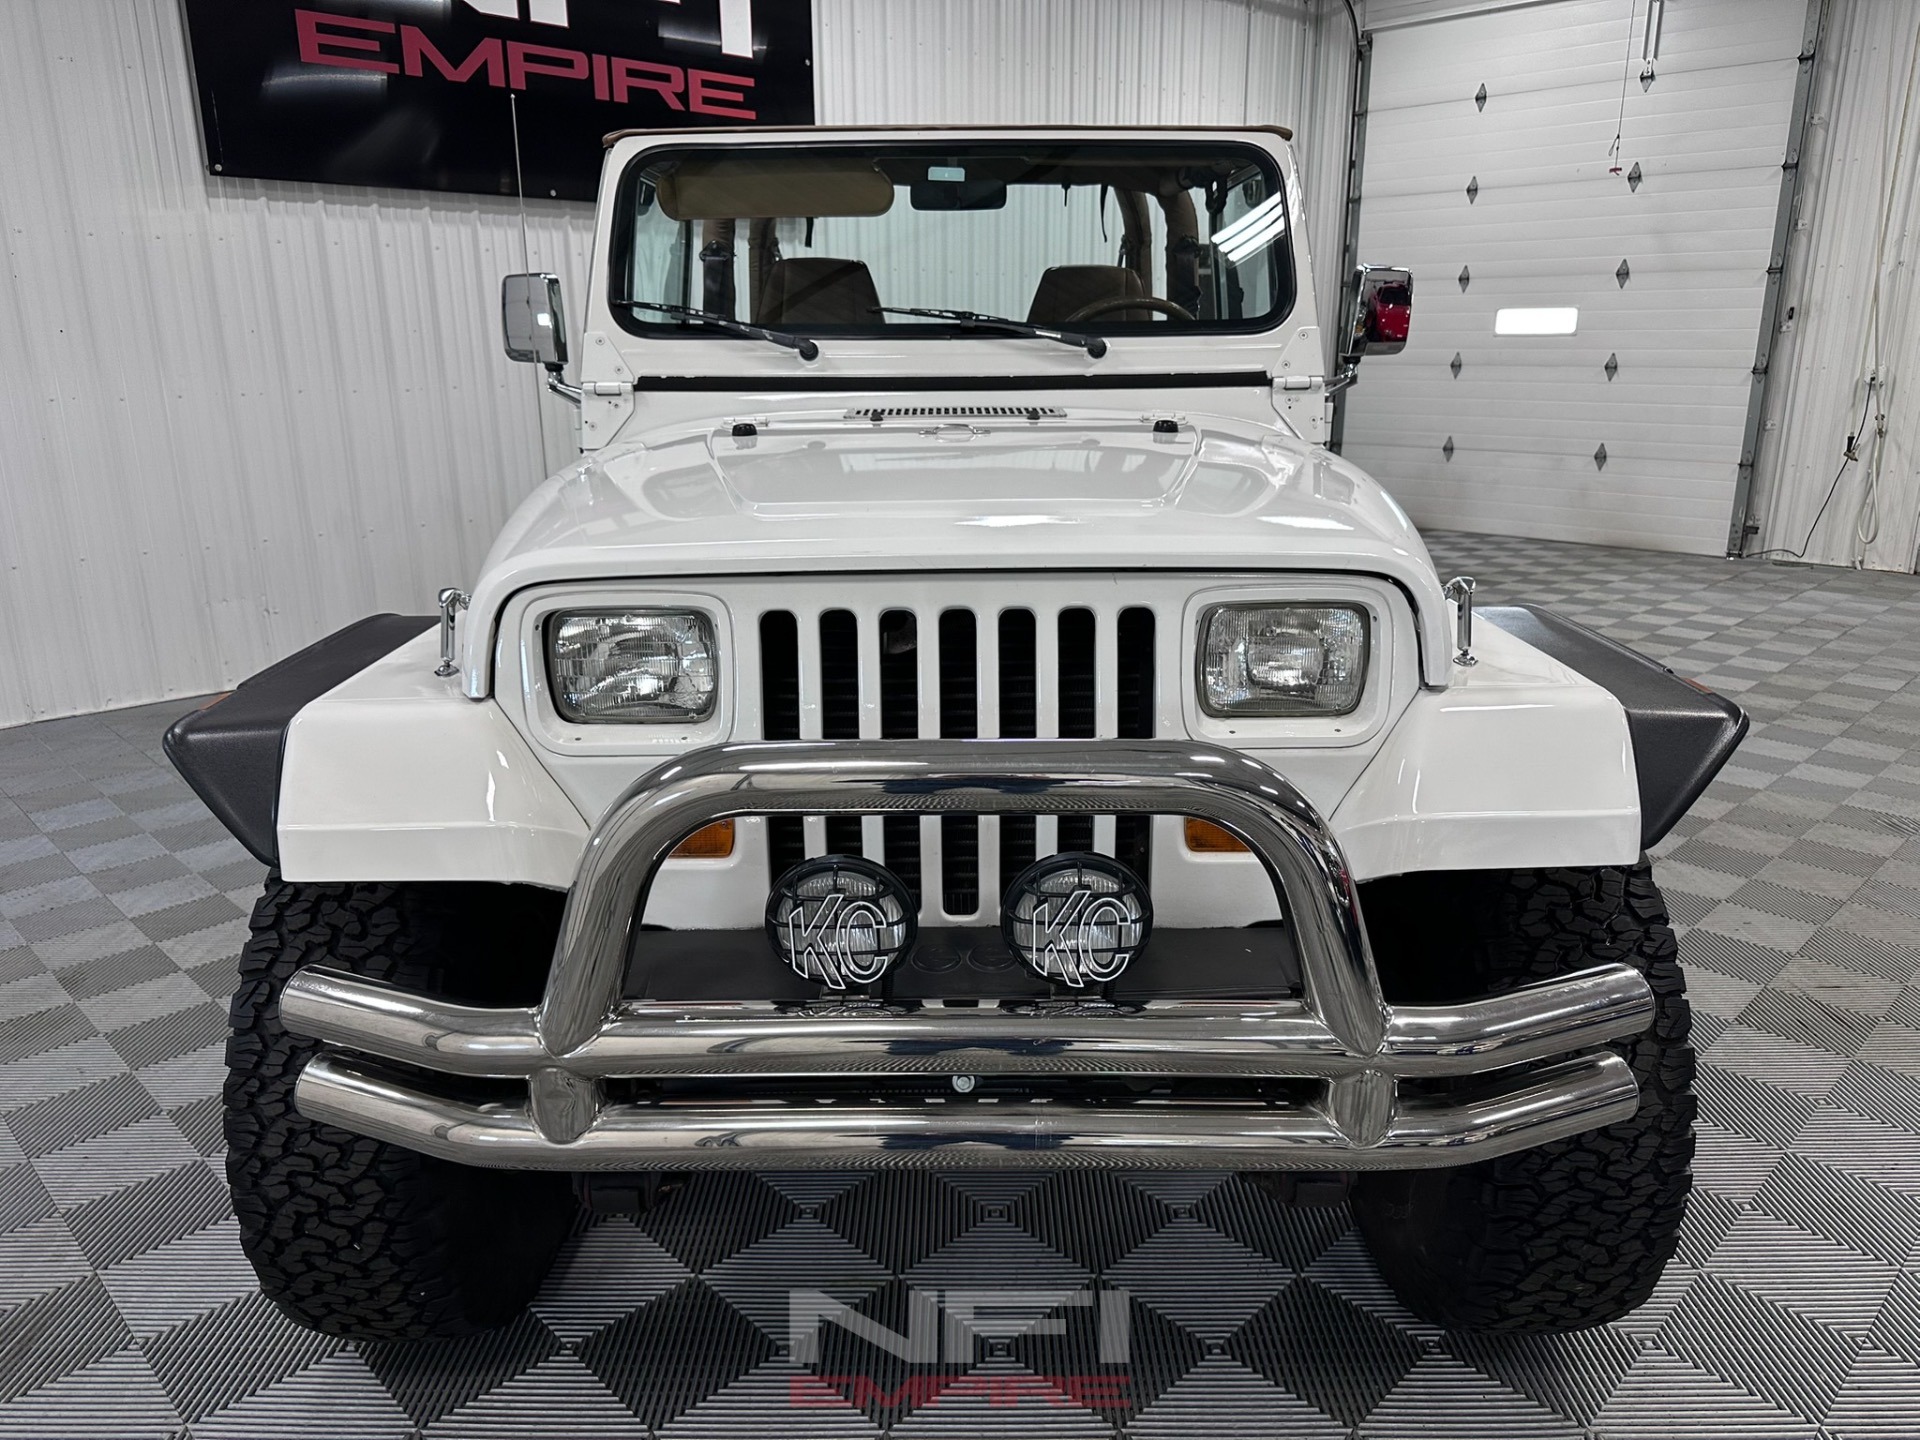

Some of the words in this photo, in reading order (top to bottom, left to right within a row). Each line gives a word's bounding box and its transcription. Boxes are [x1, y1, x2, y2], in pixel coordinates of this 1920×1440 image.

[294, 8, 757, 120] EMPIRE
[788, 893, 889, 990] KC
[1032, 890, 1132, 989] KC
